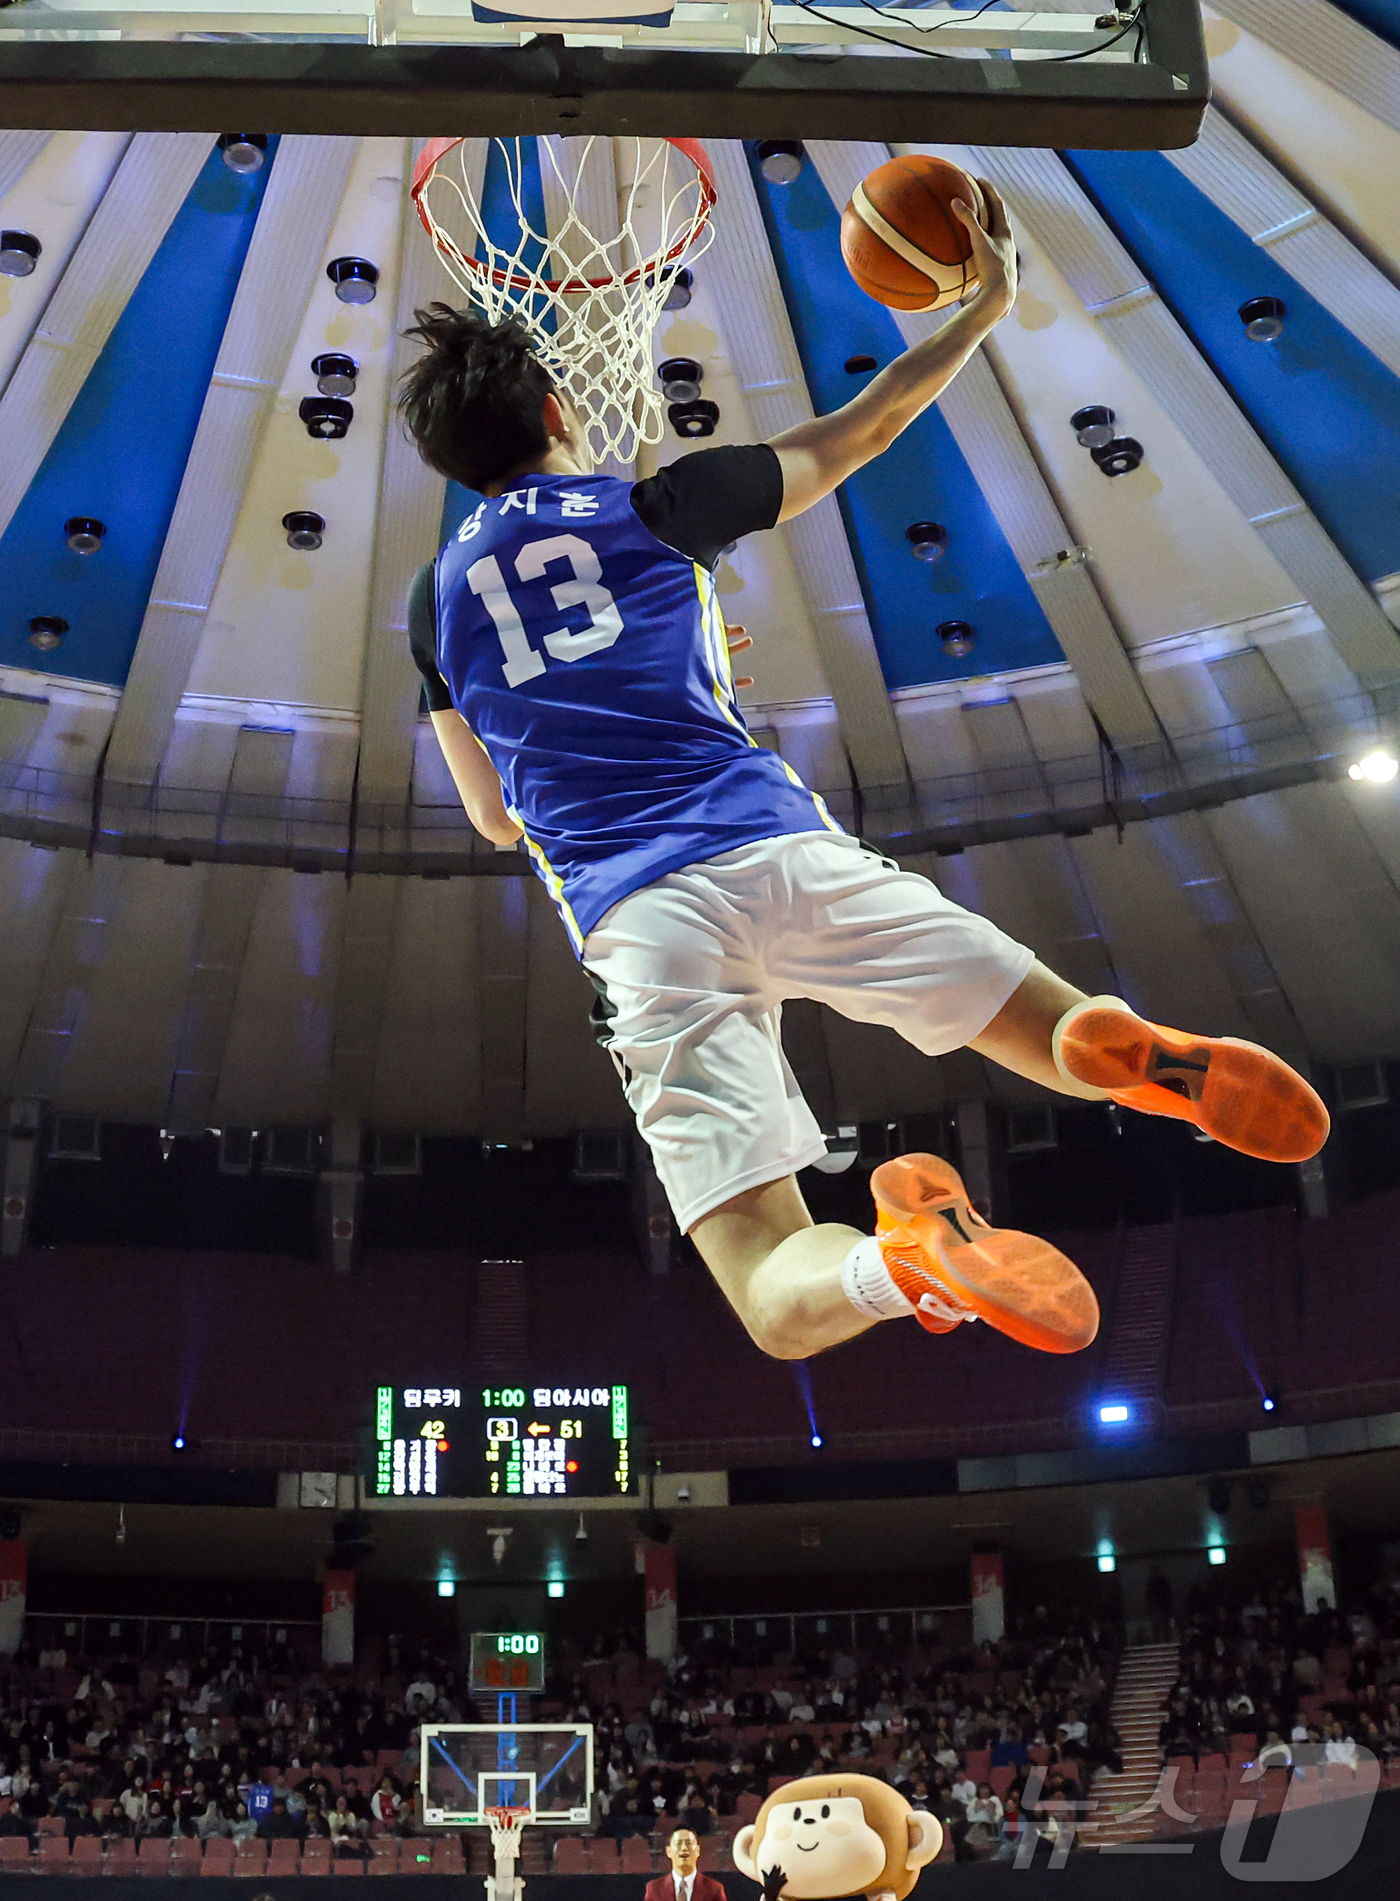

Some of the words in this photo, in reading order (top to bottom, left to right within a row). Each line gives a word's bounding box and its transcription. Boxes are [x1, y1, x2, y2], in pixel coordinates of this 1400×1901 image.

[466, 533, 625, 689] 13
[482, 1388, 525, 1408] 1:00
[533, 1388, 610, 1407] 팀아시아
[420, 1420, 445, 1439] 42
[496, 1420, 509, 1438] 3
[560, 1420, 583, 1439] 51
[378, 1451, 391, 1461] 12
[378, 1462, 391, 1472] 14
[614, 1471, 628, 1482] 17
[377, 1483, 391, 1494] 27
[498, 1634, 539, 1654] 1:00
